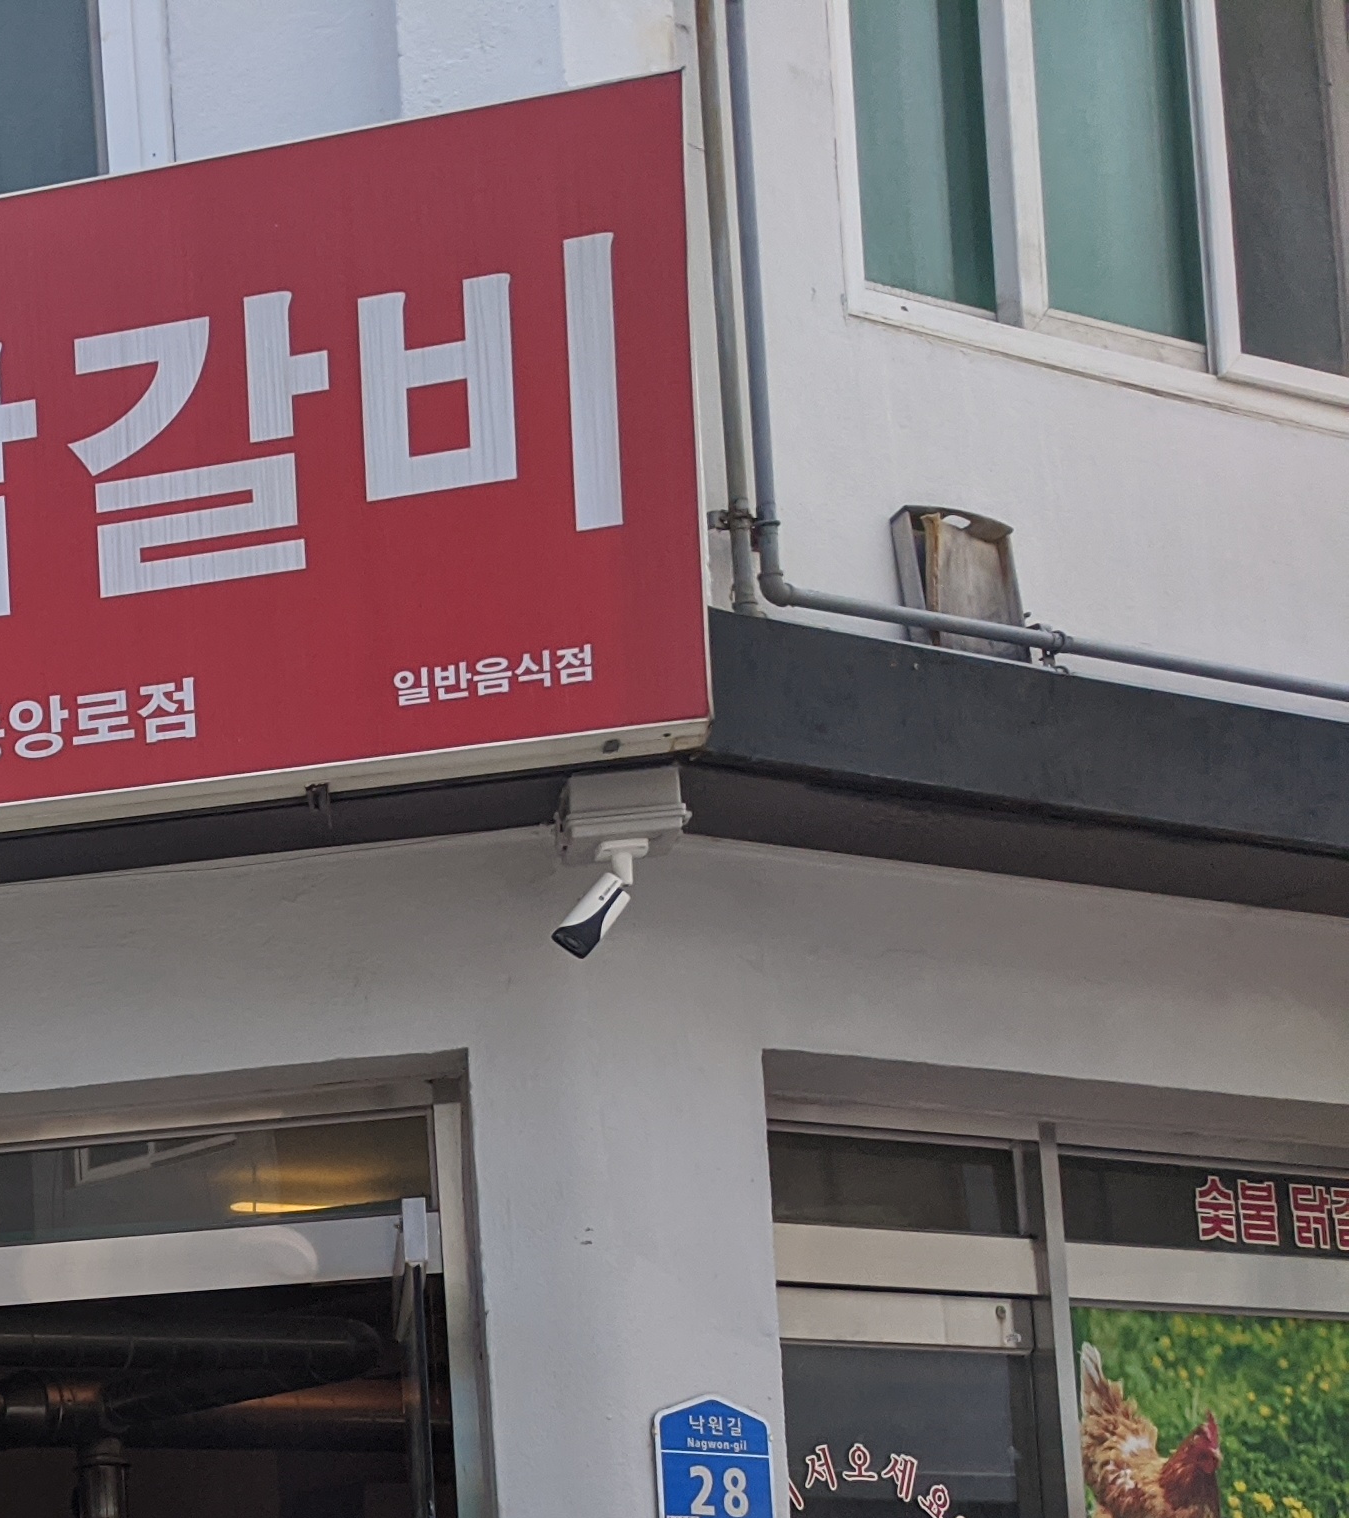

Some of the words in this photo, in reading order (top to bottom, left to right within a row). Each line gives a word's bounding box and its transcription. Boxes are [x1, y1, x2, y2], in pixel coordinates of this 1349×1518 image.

[392, 641, 595, 709] 일반음식점
[1195, 1174, 1281, 1247] 숯불
[687, 1437, 748, 1453] Nagwon-gil
[689, 1415, 744, 1438] 낙원길
[689, 1465, 750, 1518] 28
